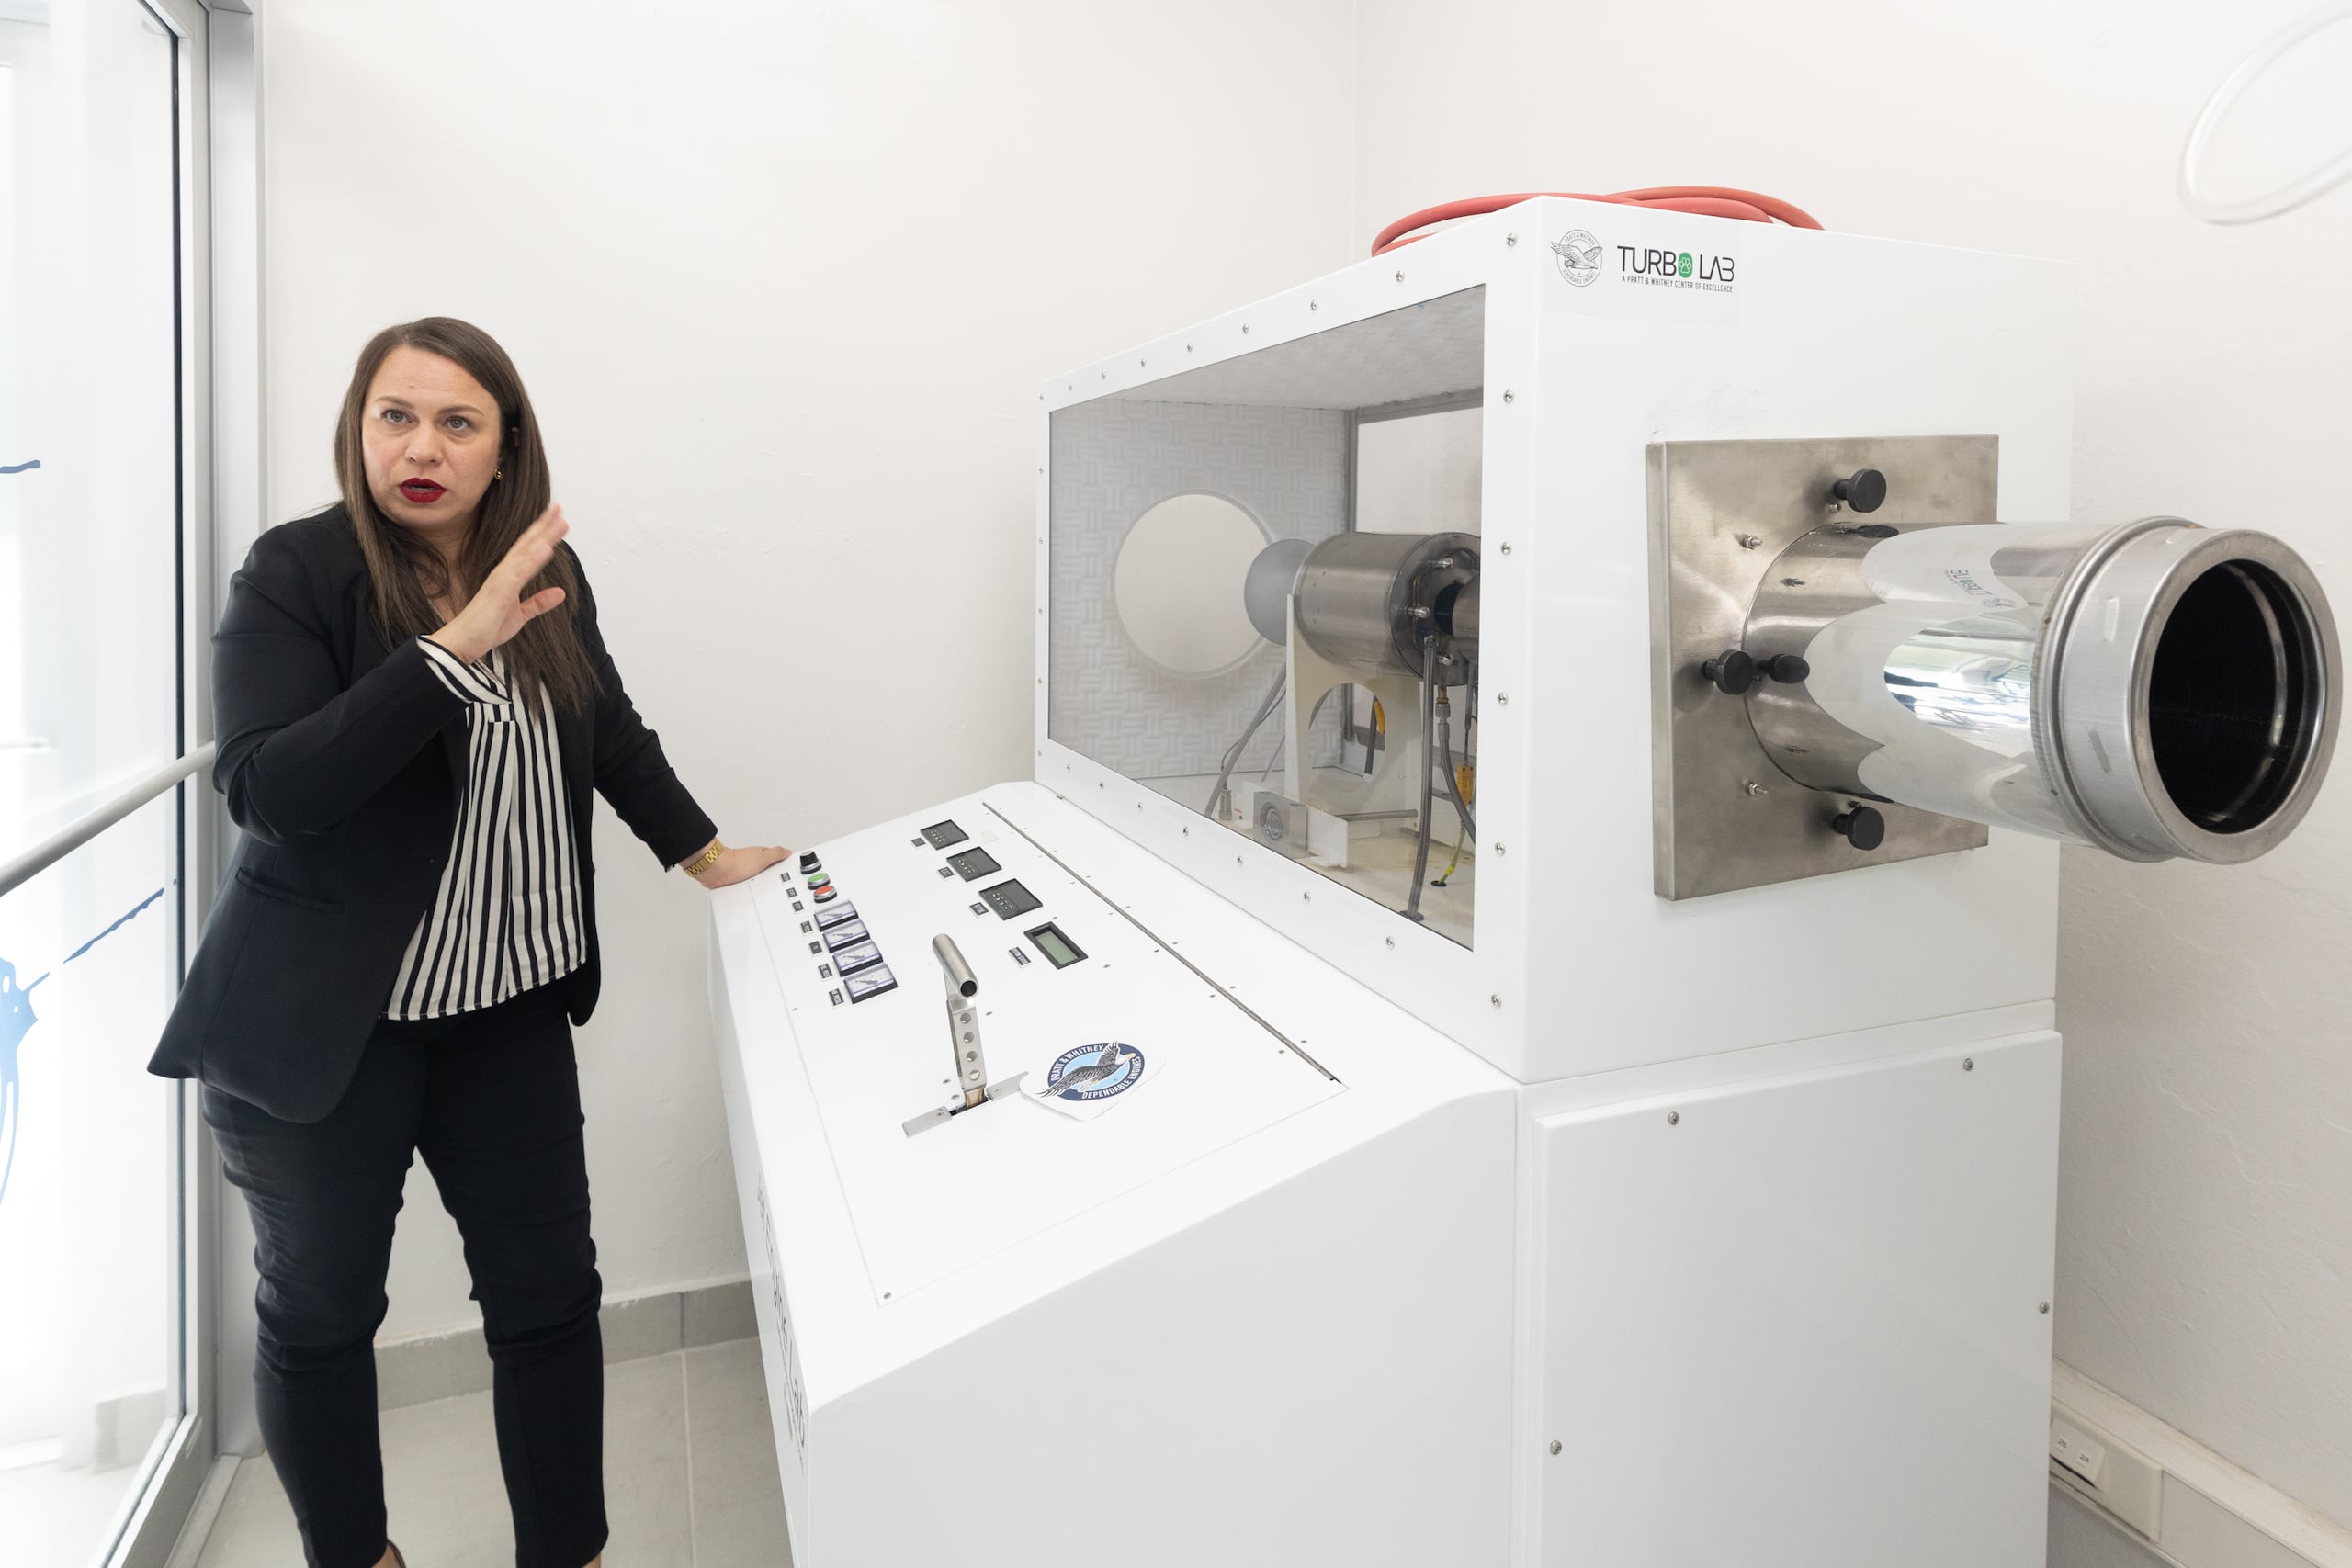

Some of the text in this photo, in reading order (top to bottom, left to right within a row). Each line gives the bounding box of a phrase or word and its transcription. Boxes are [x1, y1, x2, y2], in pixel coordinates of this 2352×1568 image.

[1617, 245, 1735, 282] TURBO LAB
[1627, 276, 1644, 285] PRATT
[1650, 278, 1673, 288] WHITNEY
[1674, 280, 1693, 289] CENTER
[1694, 282, 1702, 290] OF
[1702, 283, 1734, 293] EXCELLENCE
[1050, 1043, 1104, 1082] PRATT & WHITNEY
[1081, 1055, 1142, 1100] DEPENDABLE ENGINES
[788, 1339, 805, 1449] Lab
